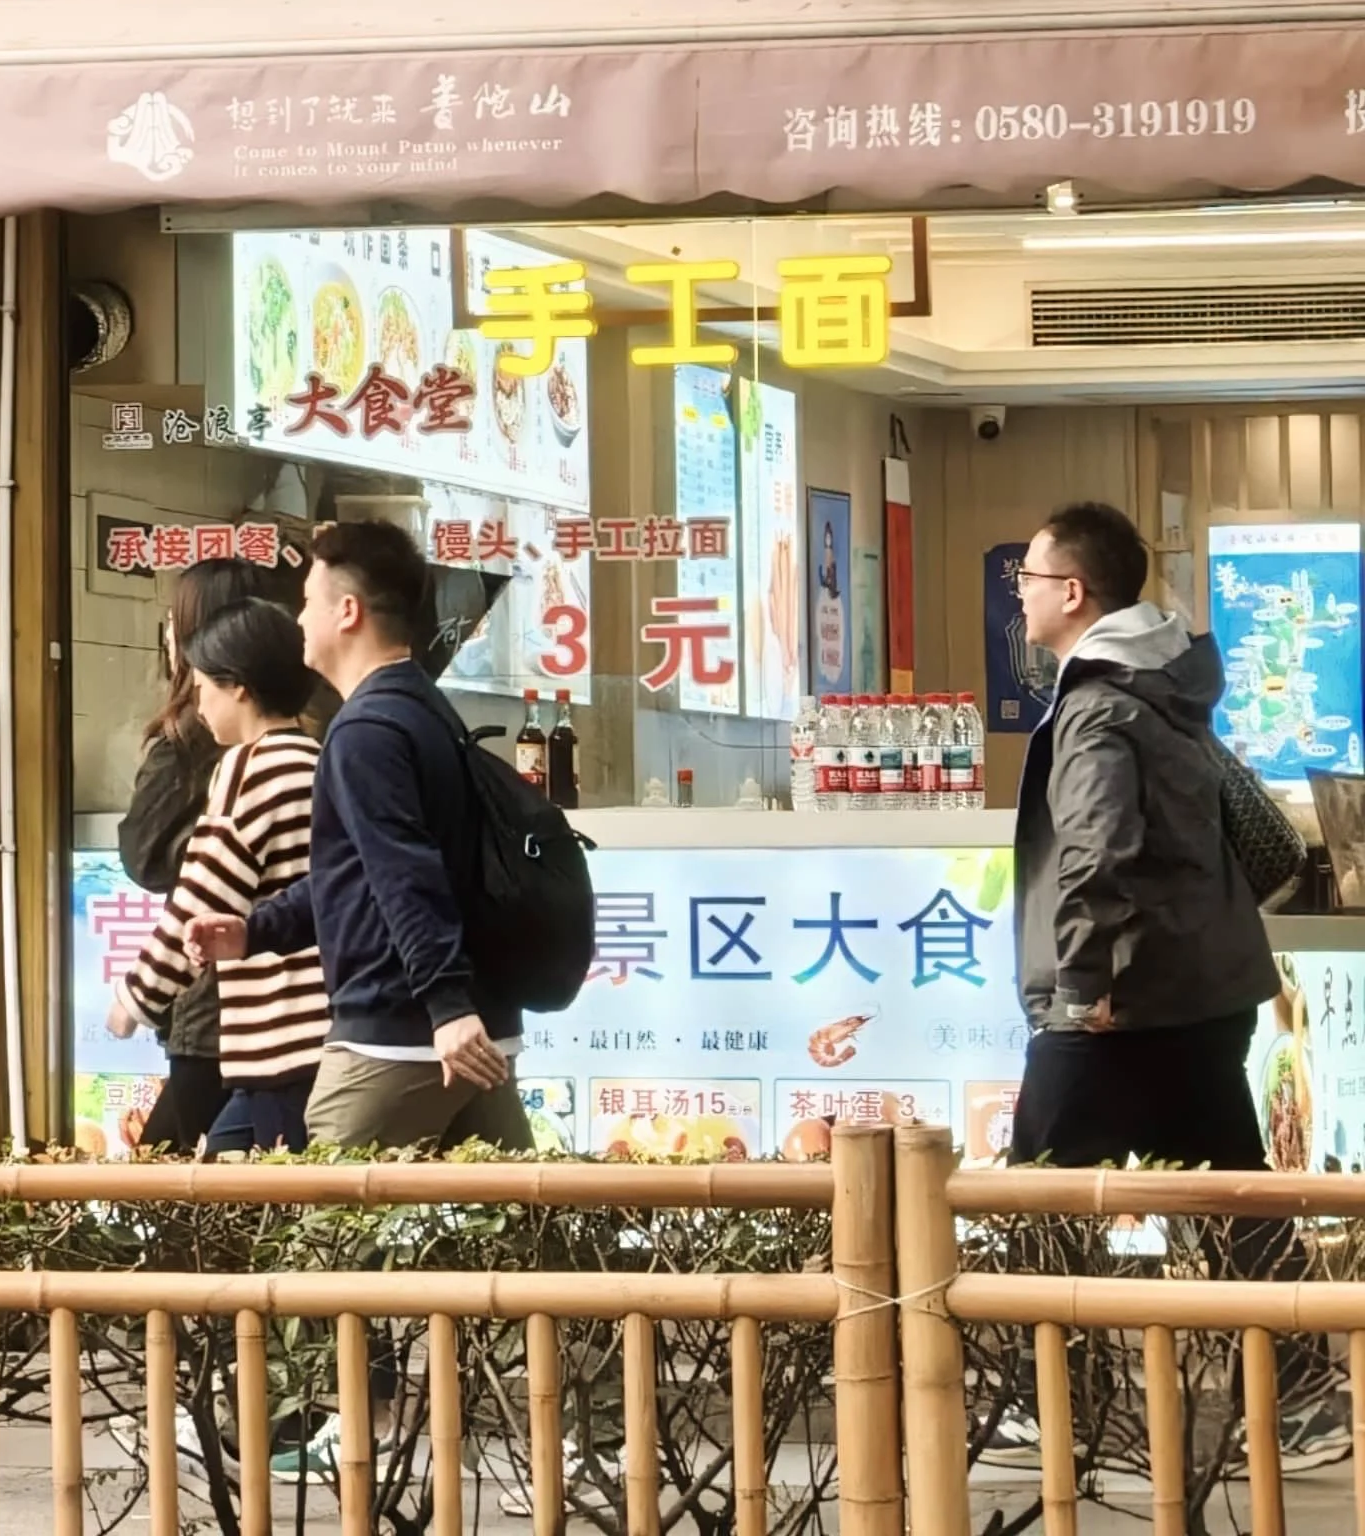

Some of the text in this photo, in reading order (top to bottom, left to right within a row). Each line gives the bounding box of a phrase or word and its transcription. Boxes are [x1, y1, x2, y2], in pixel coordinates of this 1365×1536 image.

[226, 73, 571, 132] 想到了就来 普陀山
[234, 137, 563, 160] Come to Mount Putuo whenever
[258, 163, 318, 177] comes
[327, 162, 347, 176] to
[356, 161, 403, 177] your
[410, 157, 458, 172] mind
[478, 255, 891, 375] 手工面
[164, 364, 475, 444] 沧浪亭 大食堂
[432, 515, 730, 562] 馒头、手工拉面
[105, 1082, 155, 1109] 豆浆
[789, 1089, 882, 1120] 茶叶蛋
